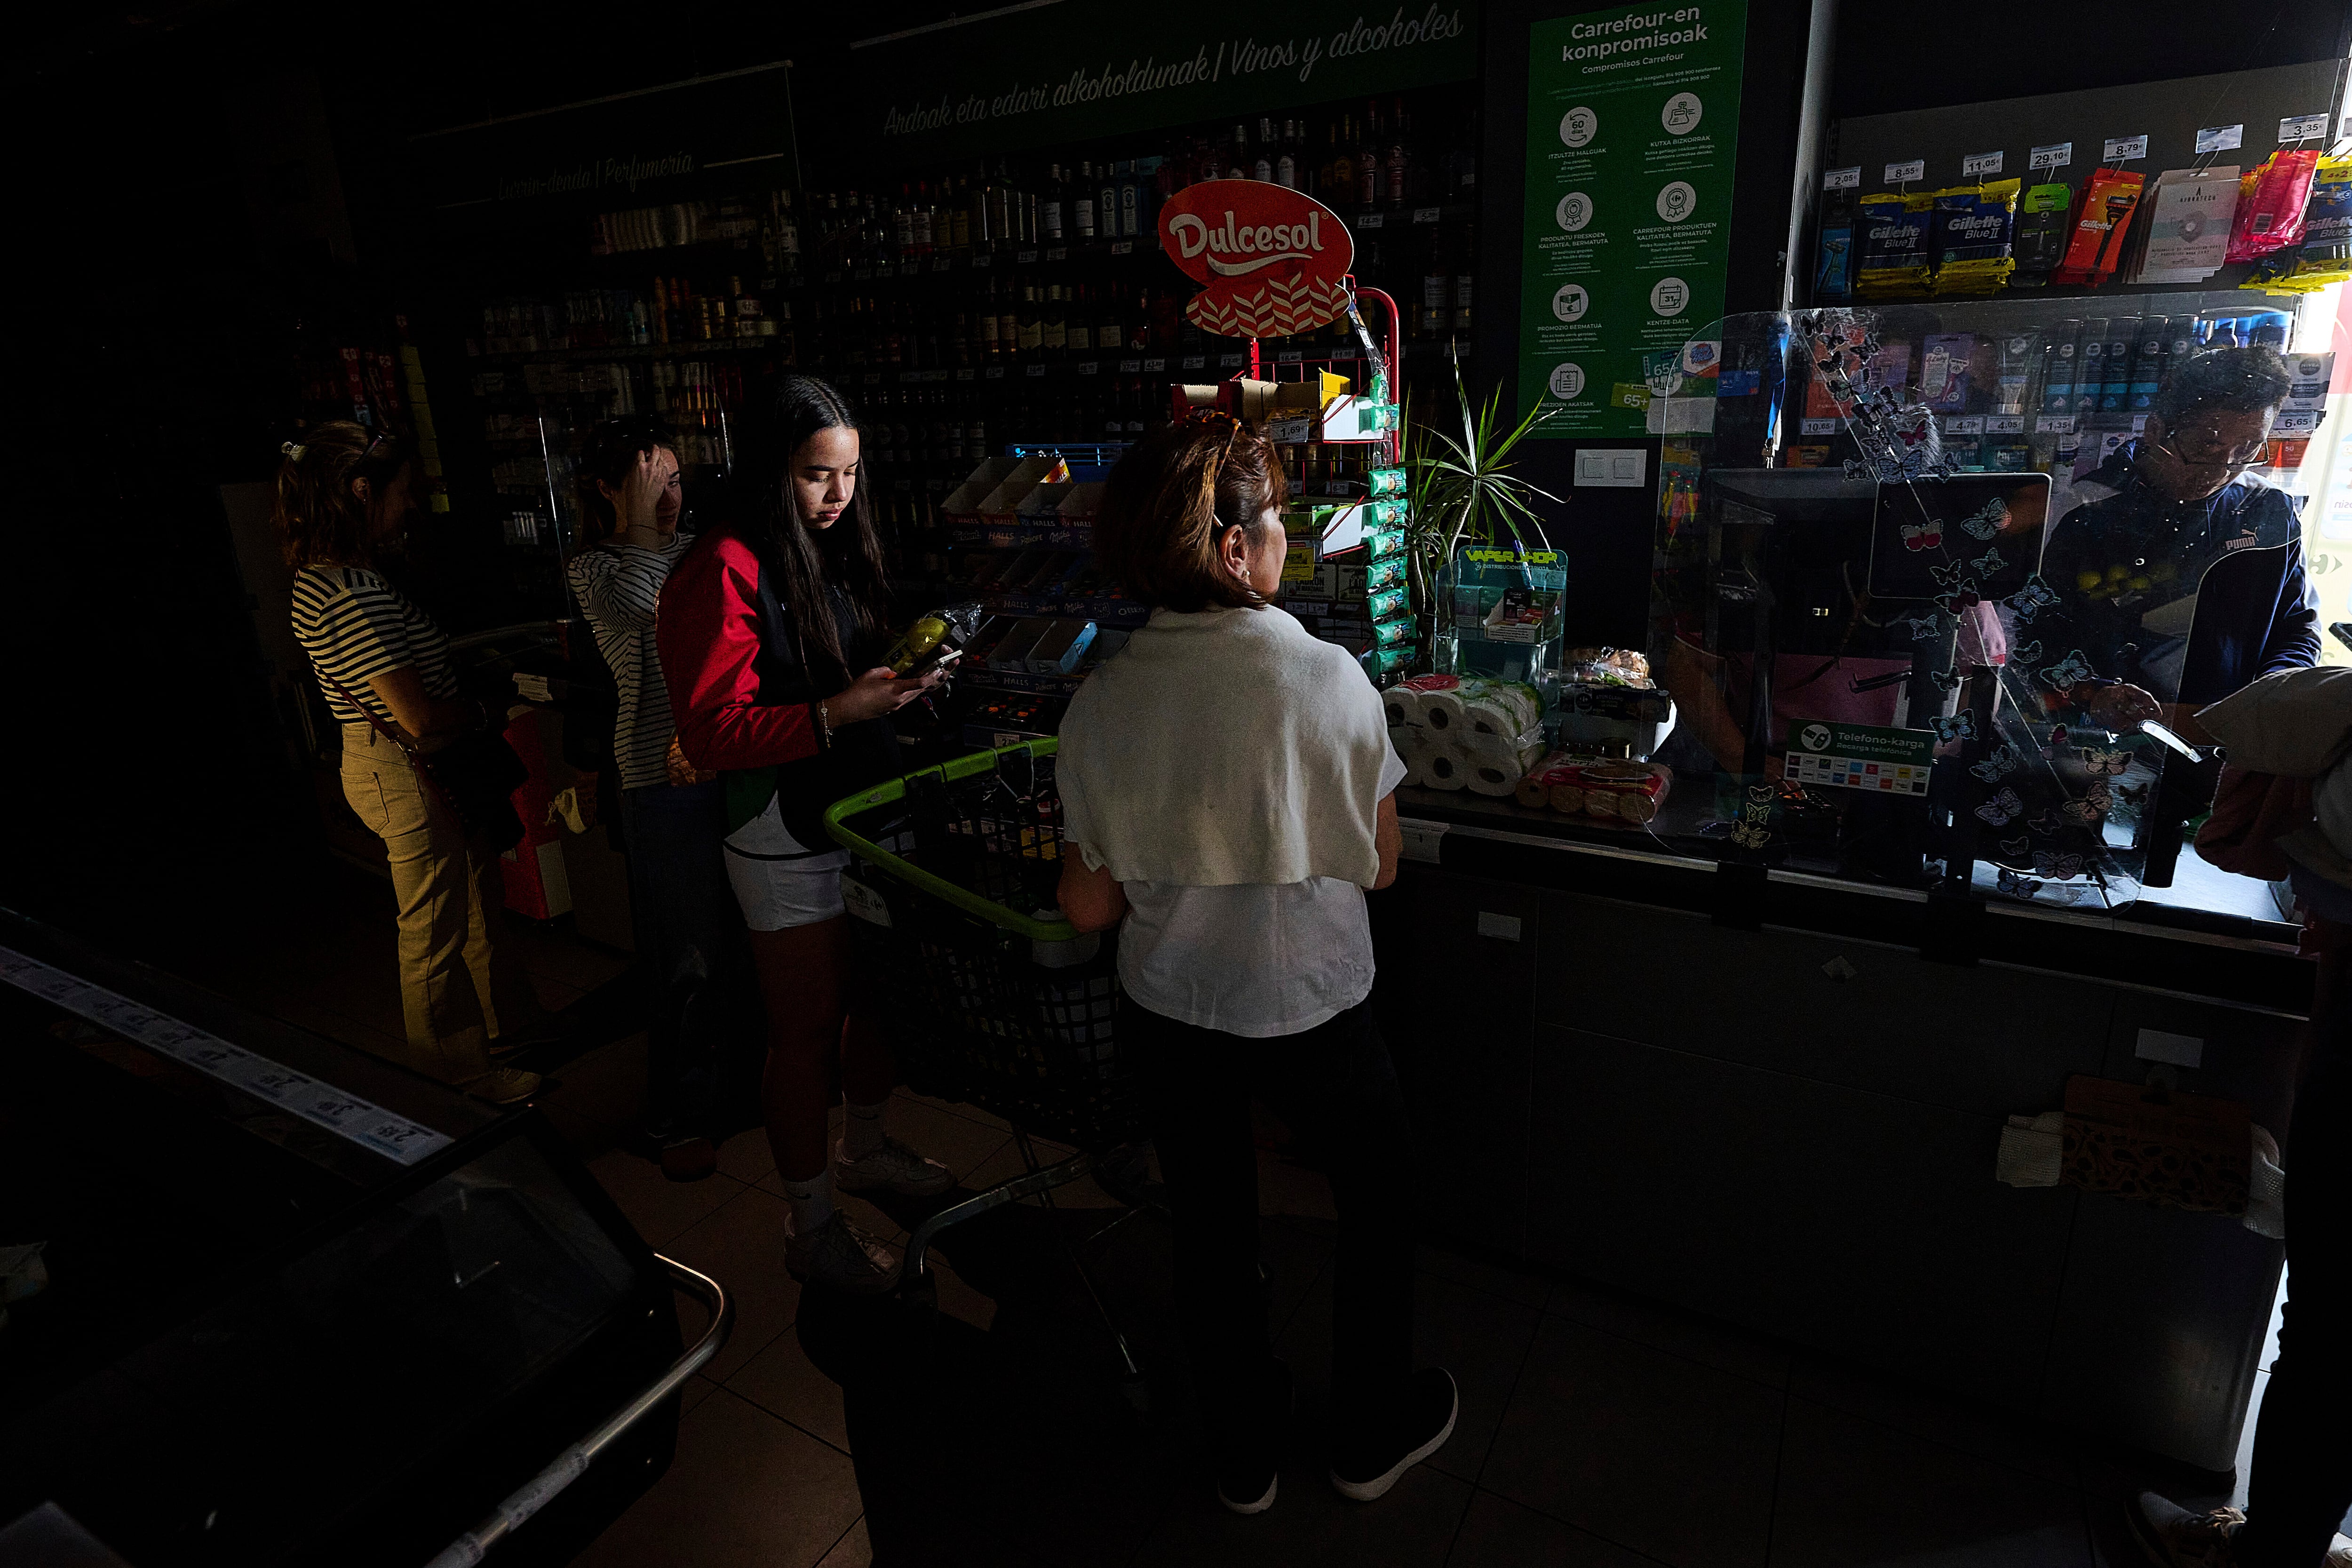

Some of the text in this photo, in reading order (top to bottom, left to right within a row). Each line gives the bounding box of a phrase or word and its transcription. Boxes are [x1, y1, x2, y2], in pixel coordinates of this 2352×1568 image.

[1571, 7, 1700, 40] Carrefour-en
[1562, 24, 1708, 62] konpromisoak
[884, 94, 953, 136] Ardoak
[956, 97, 988, 124] eta
[992, 82, 1048, 117] edari
[1053, 48, 1210, 108] alkoholdunak
[1232, 38, 1298, 74] Vinos
[1299, 38, 1322, 82] y
[1329, 2, 1464, 59] alcoholes
[1581, 52, 1685, 74] Compromisos Carrefour
[1572, 120, 1584, 129] 60
[1673, 135, 1711, 145] BIZKORRAK
[1549, 147, 1607, 160] ITZULTZE MALGUAK
[498, 164, 591, 200] Lurrin-denda
[605, 151, 694, 193] Perfumería
[1633, 222, 1717, 235] CARREFOUR PRODUKTUEN
[1948, 215, 2003, 231] Gillette
[2080, 219, 2113, 231] Gillette
[1169, 210, 1325, 259] Dulcesol
[1574, 232, 1605, 240] FRESKOEN
[1673, 229, 1712, 239] BERMATUTA
[1869, 225, 1921, 240] Gillette
[1573, 238, 1608, 247] BERMATUTA
[1624, 394, 1647, 407] 65+
[988, 531, 1014, 540] HALLS
[2225, 536, 2256, 550] PUMA
[1003, 600, 1029, 609] HALLS
[1118, 606, 1145, 615] OREO
[1003, 677, 1029, 686] HALLS
[1838, 732, 1925, 749] Telefono-karga
[1836, 742, 1912, 756] Recarga telefónica
